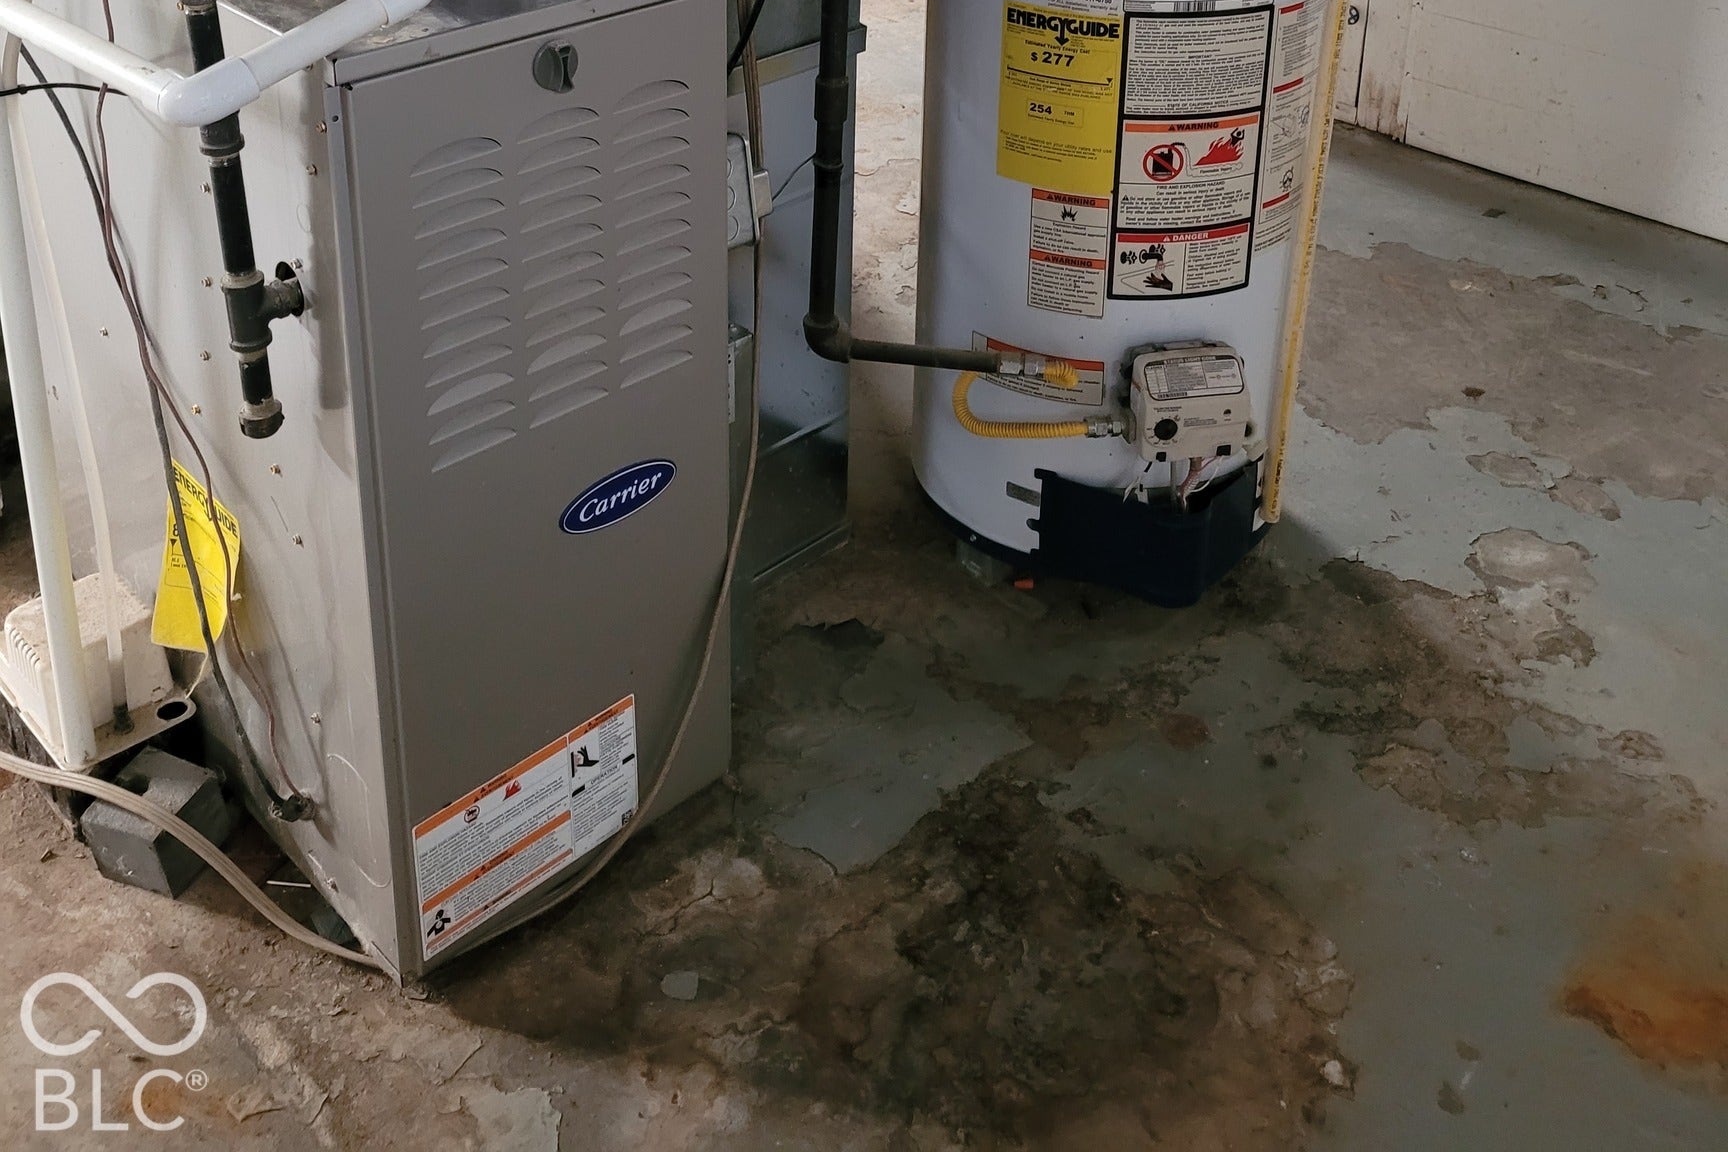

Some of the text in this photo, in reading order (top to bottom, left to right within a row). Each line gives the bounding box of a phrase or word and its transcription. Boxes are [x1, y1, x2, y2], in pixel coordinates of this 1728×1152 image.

[1007, 7, 1120, 39] ENERGYGUIDE
[1025, 39, 1046, 47] Estimated
[1062, 46, 1078, 54] Energy
[1031, 51, 1075, 67] $ 277
[1029, 102, 1052, 115] 254
[1176, 122, 1219, 131] WARNING
[1052, 194, 1096, 206] WARNING
[1172, 232, 1209, 242] DANGER
[1051, 255, 1093, 268] WARNING
[579, 471, 662, 523] Carrier
